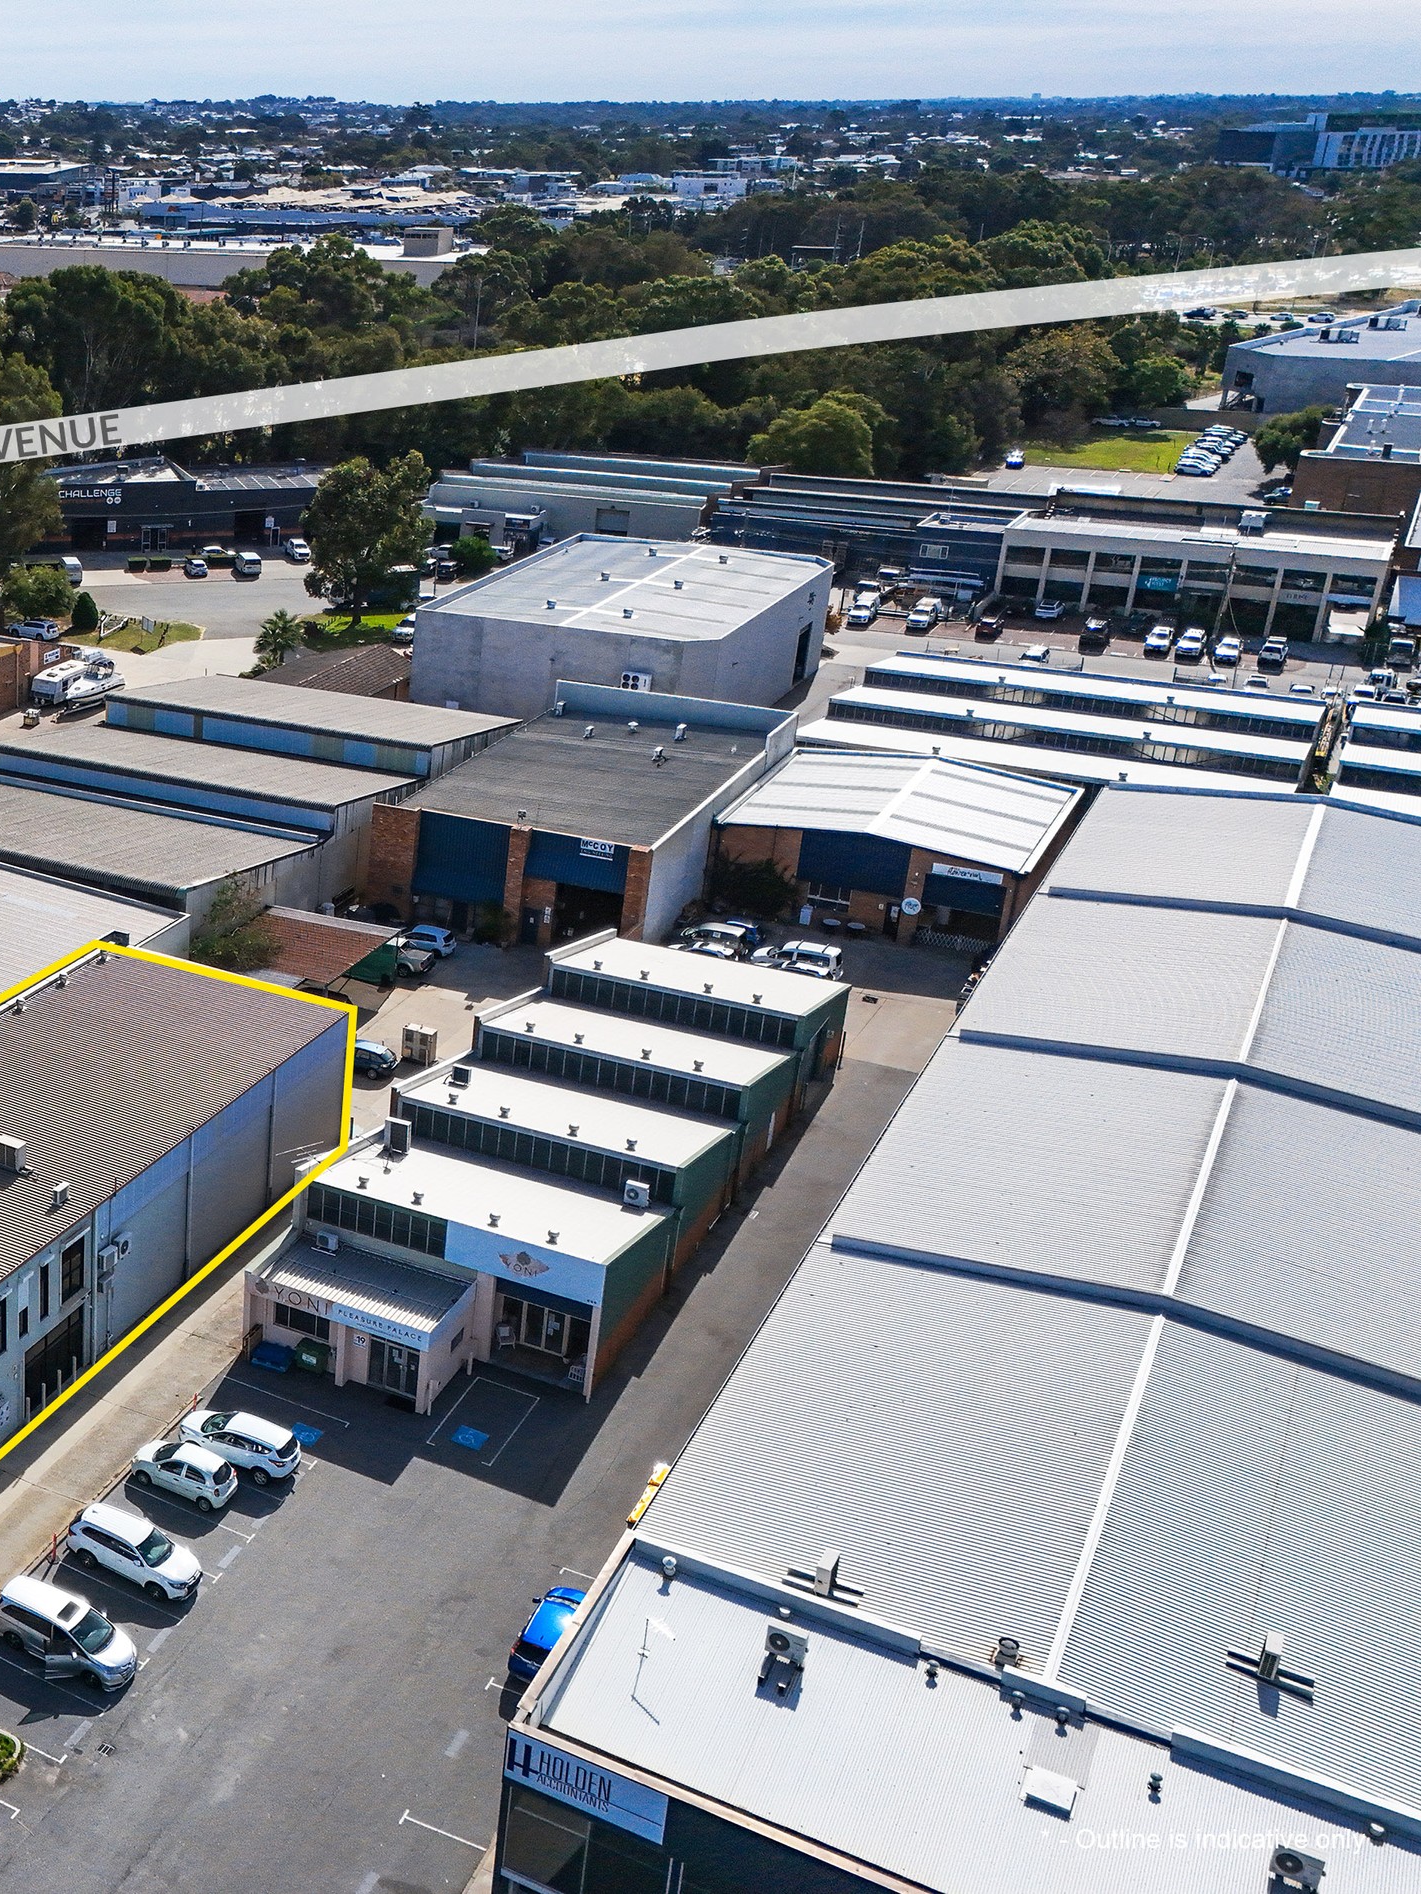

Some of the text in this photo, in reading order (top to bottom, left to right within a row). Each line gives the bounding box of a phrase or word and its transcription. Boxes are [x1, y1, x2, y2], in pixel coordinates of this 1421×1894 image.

[58, 488, 122, 499] CHALLENGE
[505, 1260, 538, 1277] YONI
[273, 1285, 329, 1316] YONI
[337, 1308, 384, 1329] PLEASURE
[387, 1325, 422, 1342] PALACE
[356, 1334, 366, 1345] 19
[539, 1750, 612, 1802] HOLDEN
[536, 1772, 610, 1813] ACCOUNTANTS
